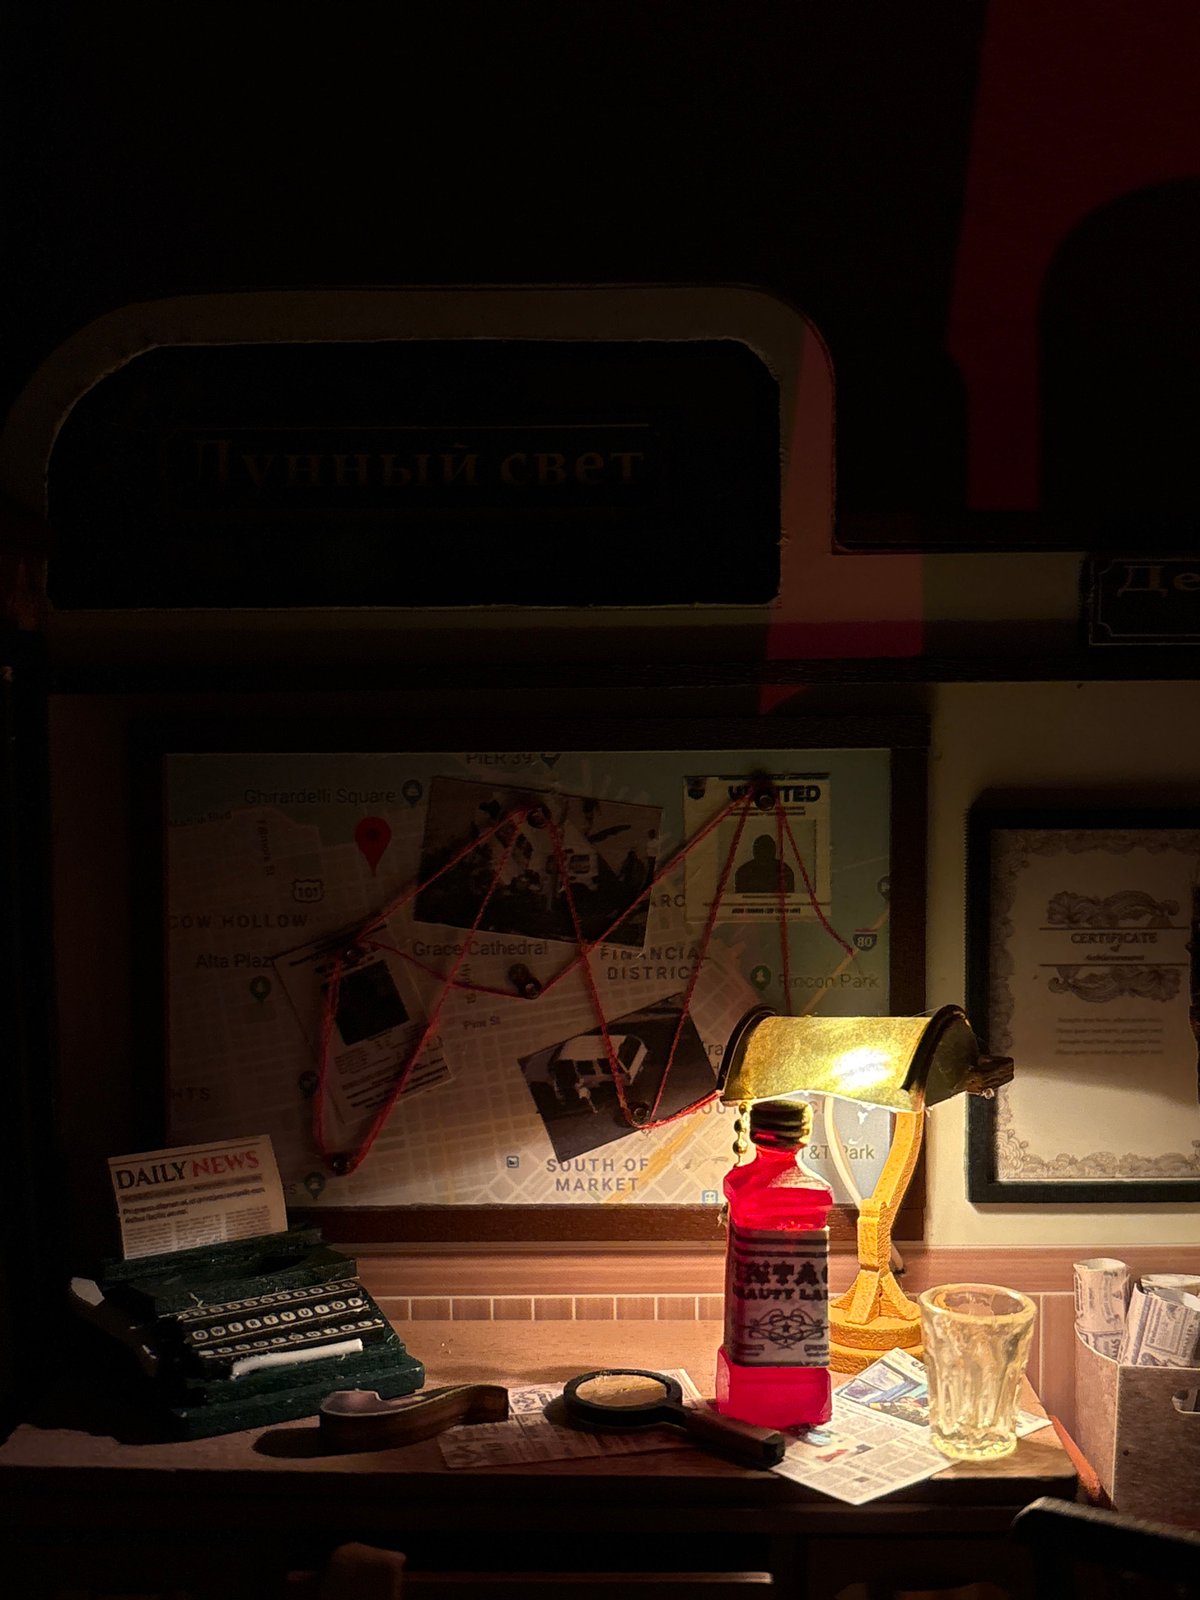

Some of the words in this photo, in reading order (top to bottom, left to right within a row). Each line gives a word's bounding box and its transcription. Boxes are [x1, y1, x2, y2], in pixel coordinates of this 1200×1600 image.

[194, 438, 481, 489] Лунный
[500, 450, 645, 488] свет
[244, 788, 331, 804] Ghirardelli
[336, 788, 396, 806] Square
[728, 785, 821, 803] WTED
[298, 886, 319, 898] 101
[222, 914, 310, 928] HOLLOW
[856, 936, 873, 947] 80
[1070, 931, 1159, 944] CERTIFICATE
[412, 940, 464, 956] Grace
[465, 940, 548, 956] Cathedral
[196, 953, 230, 969] Alta
[234, 953, 274, 969] Plaz
[840, 973, 880, 988] Park
[115, 1160, 188, 1190] DAILY
[191, 1150, 260, 1177] NEWS
[546, 1157, 615, 1173] SOUTH
[625, 1157, 650, 1172] OF
[555, 1177, 640, 1192] MARKET
